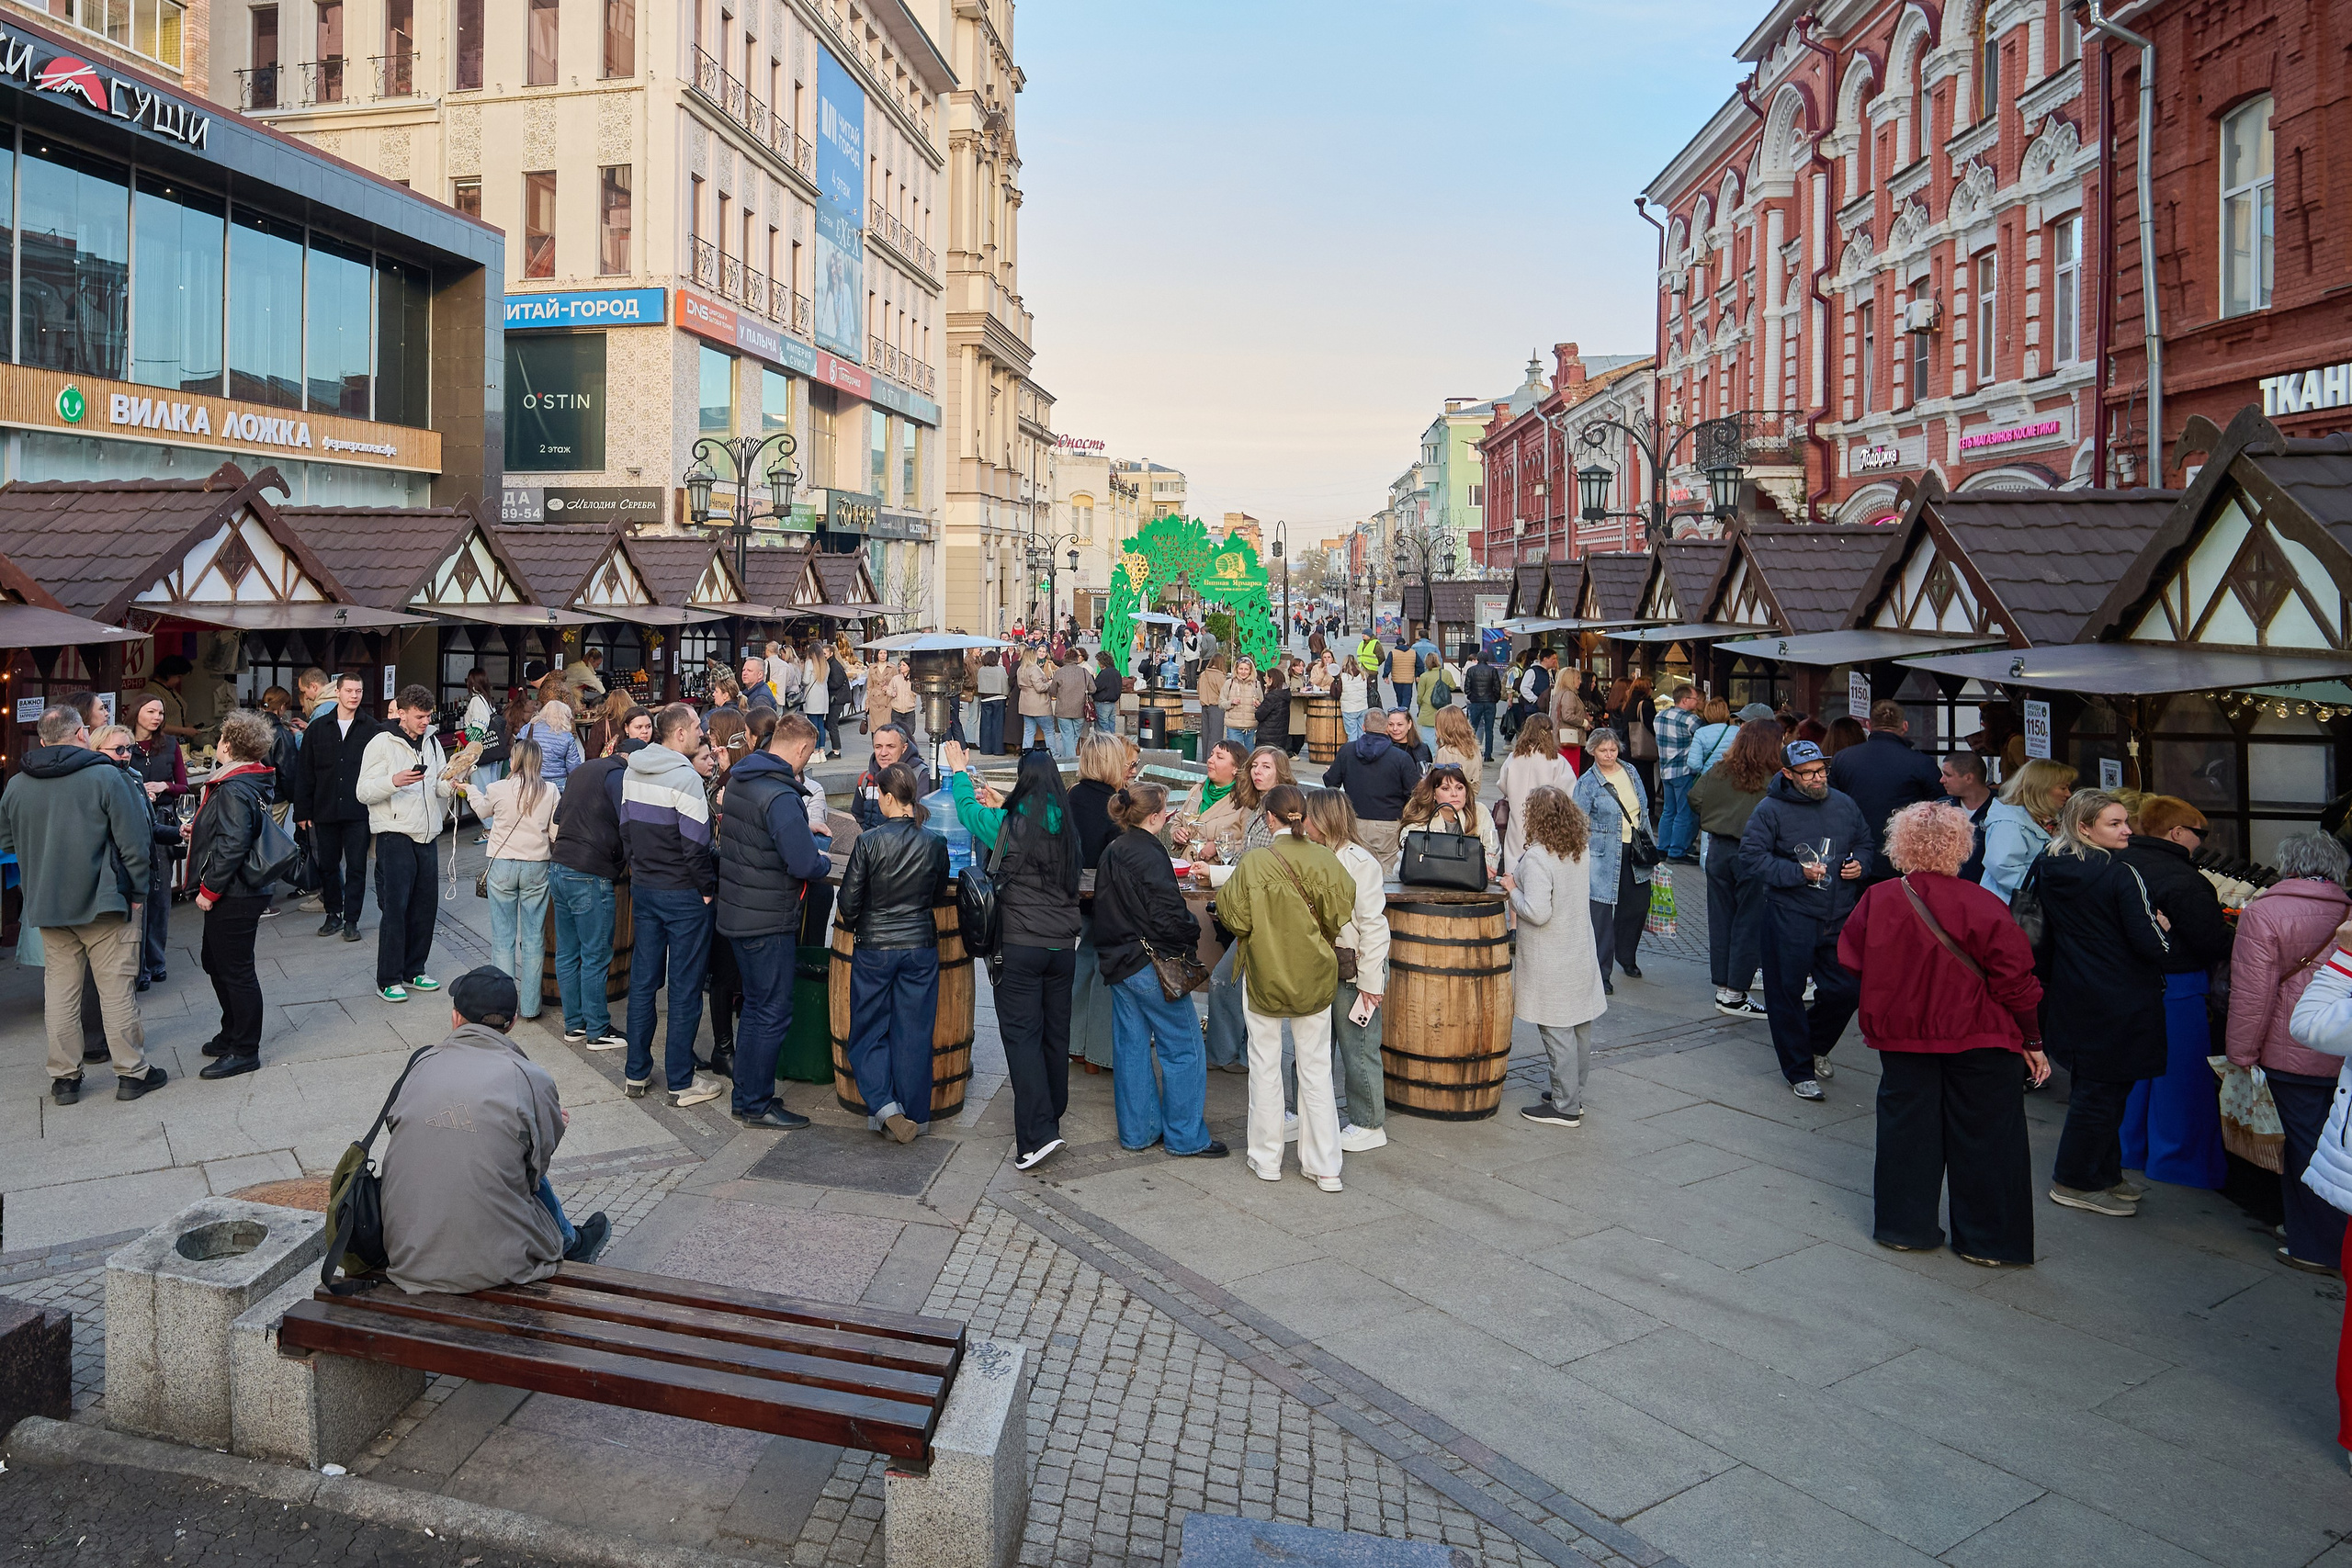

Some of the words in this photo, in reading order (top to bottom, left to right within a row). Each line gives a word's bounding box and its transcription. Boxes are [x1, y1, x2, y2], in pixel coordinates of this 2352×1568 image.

[838, 112, 860, 148] ЧИТАЙ
[838, 133, 860, 171] ГОРОД
[831, 169, 836, 186] 4
[836, 176, 851, 200] этаж
[504, 299, 639, 321] ИТАЙ-ГОРОД
[686, 298, 709, 321] DNS
[740, 324, 745, 340] У
[746, 326, 777, 354] ПАЛЫЧА
[786, 341, 812, 360] ИМПЕРИЯ
[789, 355, 808, 370] СУМОК
[2259, 362, 2352, 416] ТКАН
[109, 393, 211, 435] ВИЛКА
[221, 412, 312, 448] ЛОЖКА
[1959, 436, 1973, 450] СЕТЬ
[1973, 432, 2013, 448] МАГАЗИНОВ
[2013, 421, 2058, 442] КОСМЕТИКИ
[539, 445, 546, 454] 2
[548, 446, 571, 454] этаж
[1859, 446, 1897, 469] Подружка
[1232, 579, 1262, 587] Ярмарка
[19, 698, 43, 706] ВАЖНО!
